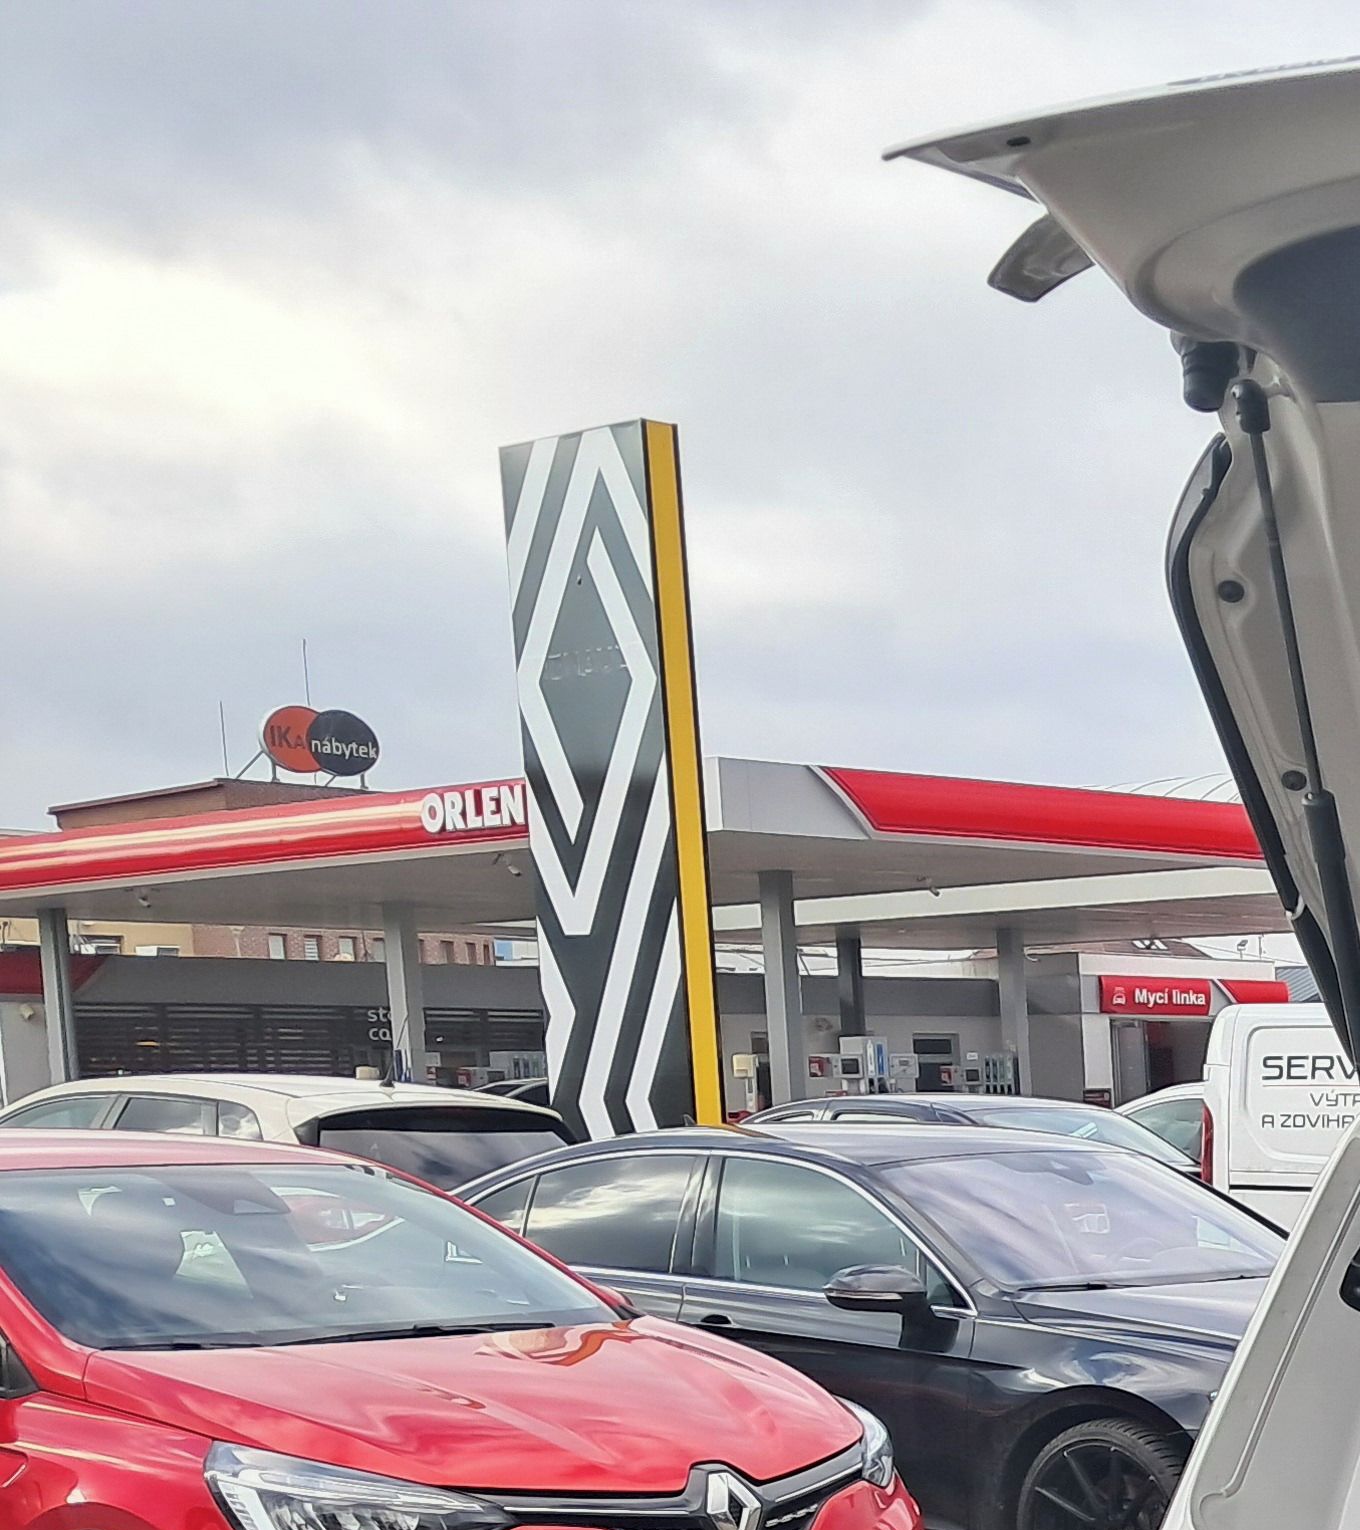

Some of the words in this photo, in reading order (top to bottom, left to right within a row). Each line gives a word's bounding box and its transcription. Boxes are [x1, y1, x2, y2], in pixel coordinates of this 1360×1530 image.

[311, 735, 377, 759] nábytek
[421, 783, 526, 833] ORLEN
[1134, 987, 1168, 1008] Mycí
[1172, 989, 1206, 1005] linka
[1261, 1055, 1357, 1081] SERV
[1261, 1114, 1275, 1129] A
[1280, 1114, 1355, 1129] ZDVIHA
